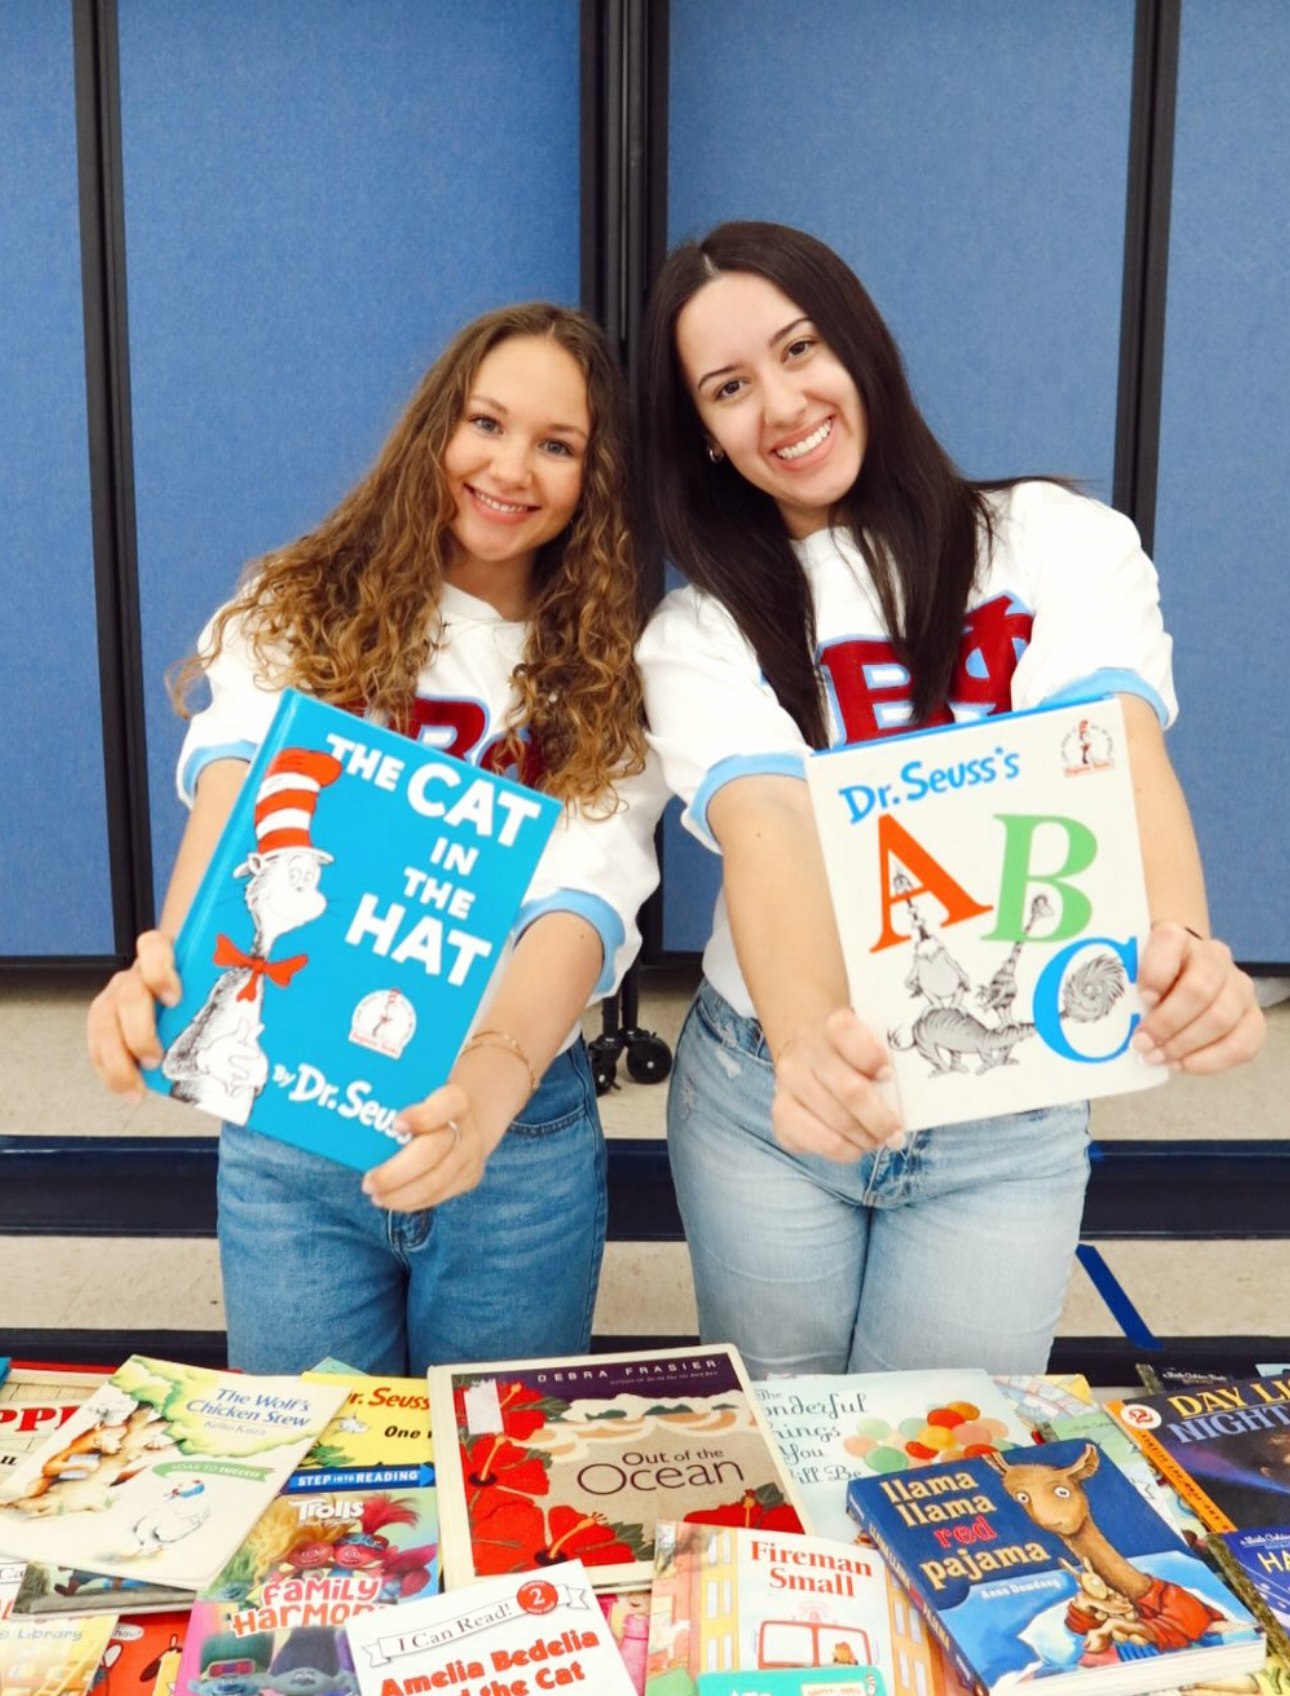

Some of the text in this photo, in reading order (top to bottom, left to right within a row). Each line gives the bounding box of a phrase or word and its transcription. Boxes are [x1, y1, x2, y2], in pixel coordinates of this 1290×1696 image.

[326, 734, 541, 847] THE CAT
[838, 784, 900, 825] Dr.
[430, 837, 478, 876] IN
[403, 868, 476, 920] THE
[345, 893, 492, 987] HAT
[288, 1063, 339, 1109] Dr.
[537, 1370, 607, 1383] DEBRA
[625, 1359, 717, 1376] FRASIER
[217, 1389, 250, 1404] The
[348, 1392, 363, 1404] r.
[765, 1392, 868, 1419] onderful
[1168, 1379, 1290, 1417] DAY LI
[186, 1400, 312, 1427] Chicken Stew
[384, 1425, 420, 1439] One
[622, 1449, 724, 1466] Out of the
[298, 1474, 331, 1487] STEP
[356, 1470, 418, 1483] READING
[577, 1461, 744, 1495] Ocean
[789, 1466, 822, 1484] ill
[880, 1472, 979, 1503] llama
[896, 1495, 997, 1527] llama
[934, 1516, 997, 1548] red
[751, 1541, 872, 1577] Fireman
[920, 1542, 1051, 1590] pajama
[529, 1588, 546, 1605] 2
[769, 1567, 854, 1597] Small
[412, 1630, 453, 1648] Can
[456, 1602, 513, 1634] Read!
[381, 1629, 600, 1696] Amelia Bedelia
[535, 1661, 585, 1689] Cat
